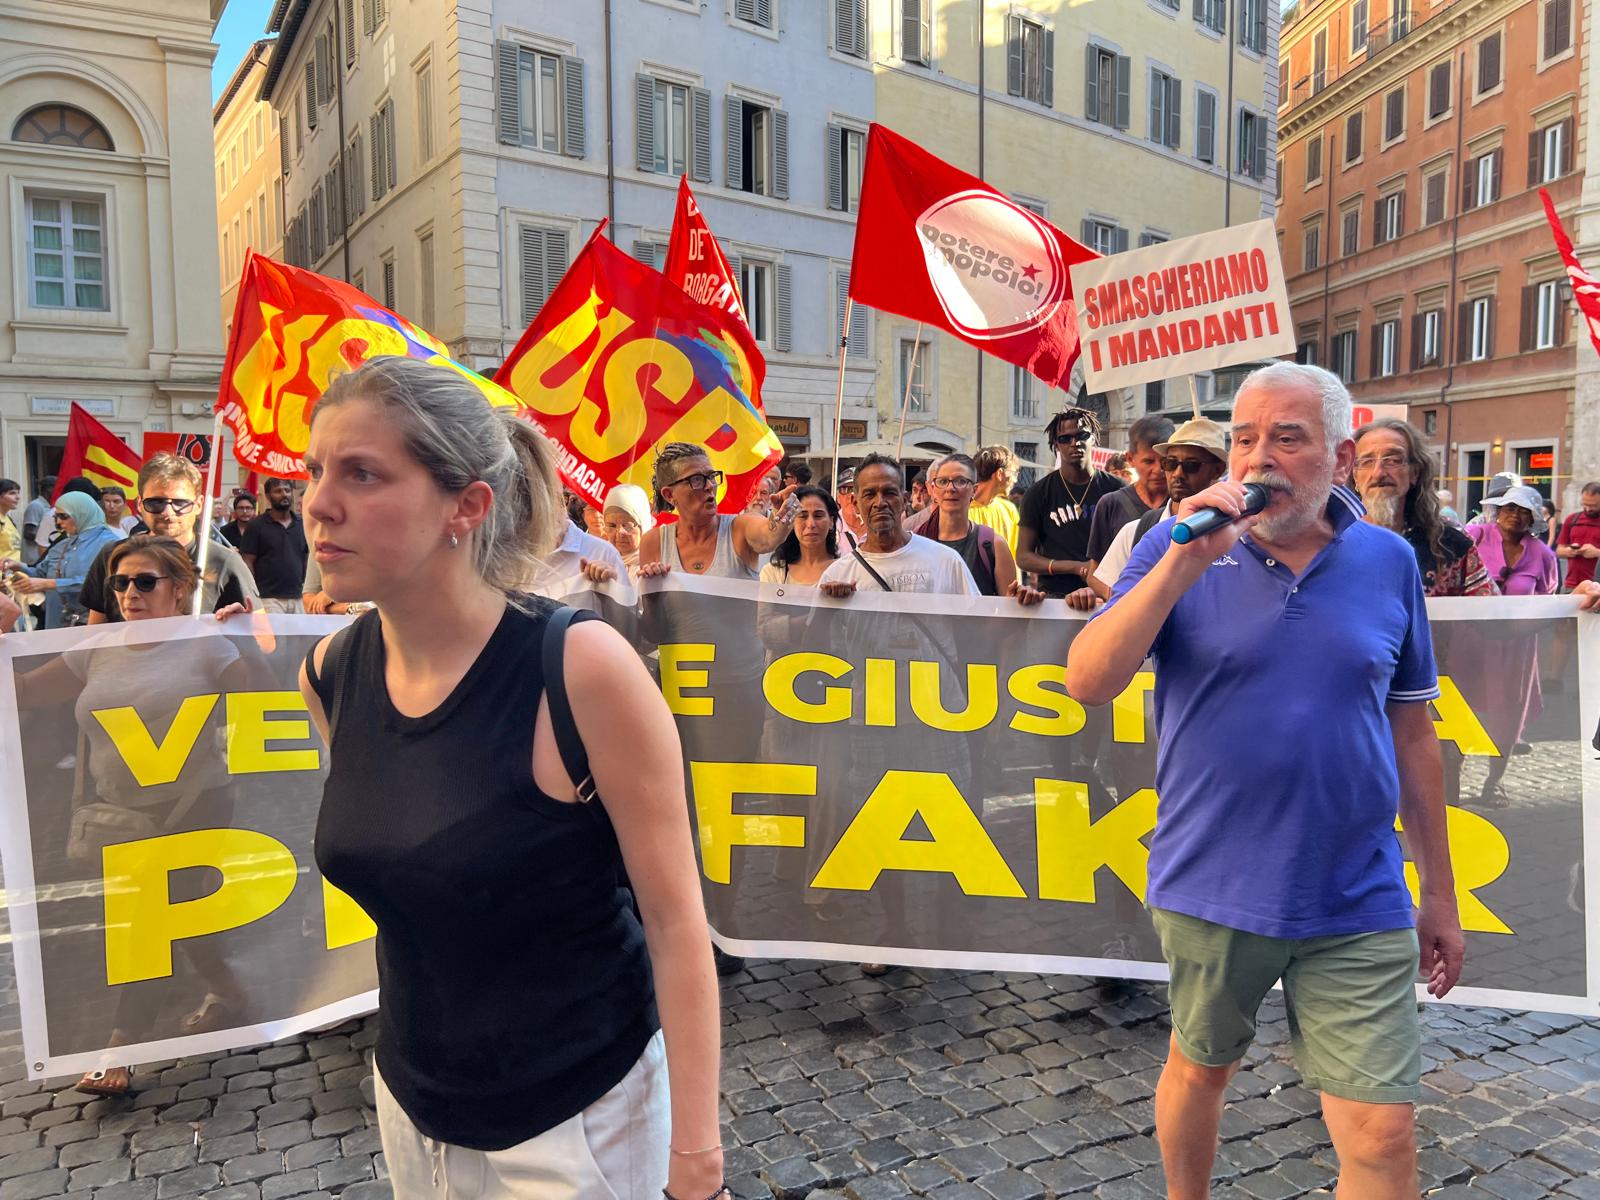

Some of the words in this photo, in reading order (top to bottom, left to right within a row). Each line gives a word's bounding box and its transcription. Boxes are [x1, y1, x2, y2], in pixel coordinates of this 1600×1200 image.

[922, 223, 1016, 272] potere
[1083, 247, 1270, 330] SMASCHERIAMO
[1090, 339, 1103, 373] I
[1108, 301, 1280, 369] MANDANTI
[548, 436, 607, 505] SINDACAL
[658, 643, 717, 717] E
